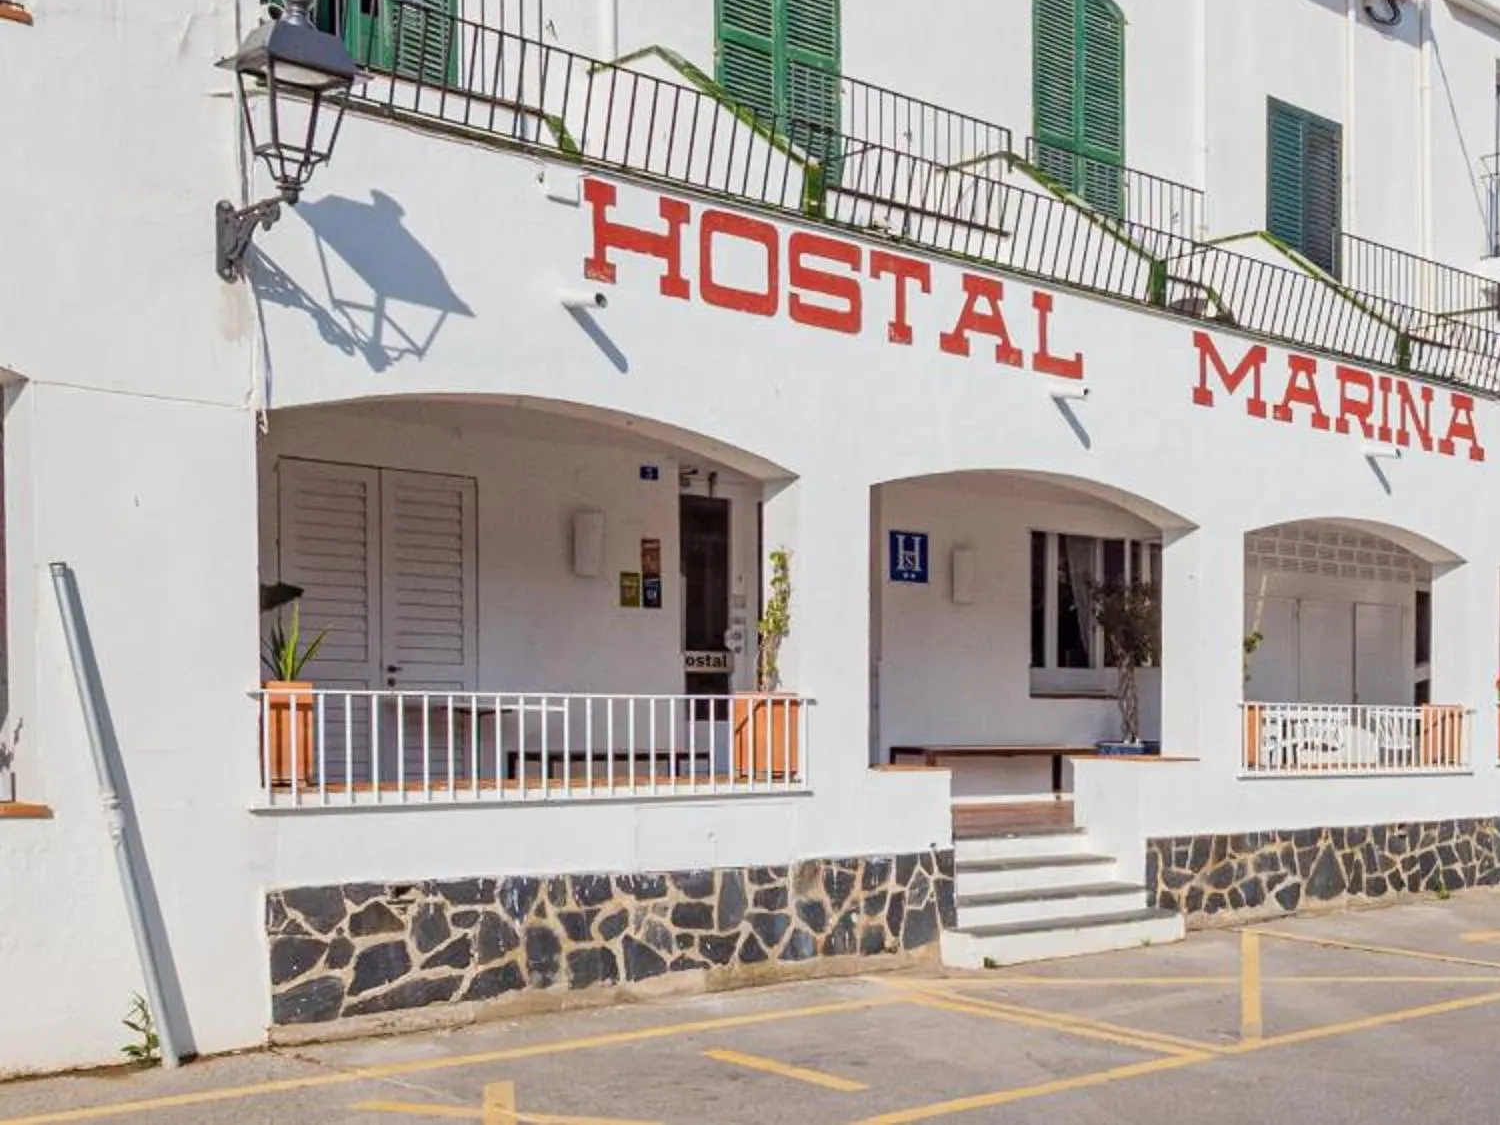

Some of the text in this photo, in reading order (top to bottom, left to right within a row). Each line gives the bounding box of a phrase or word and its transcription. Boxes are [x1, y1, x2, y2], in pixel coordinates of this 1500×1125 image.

[583, 177, 1486, 461] HOSTAL MARINA
[685, 654, 729, 668] ostal
